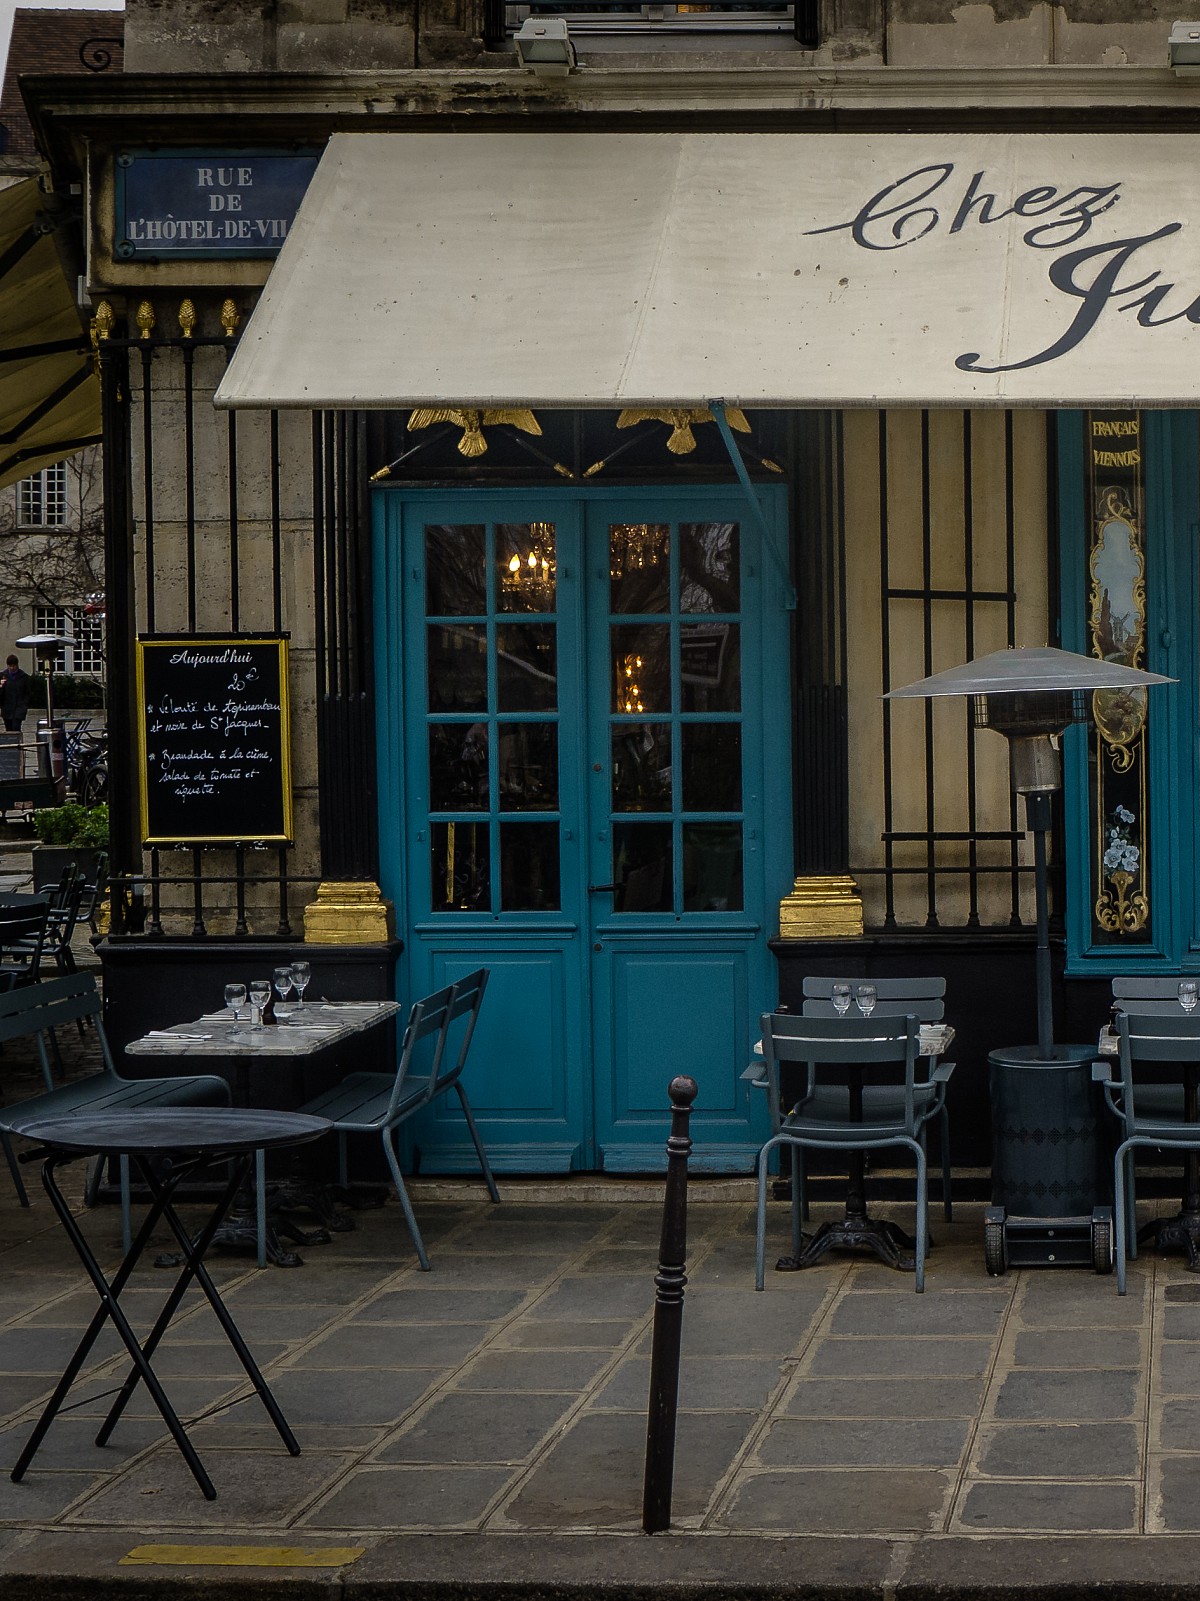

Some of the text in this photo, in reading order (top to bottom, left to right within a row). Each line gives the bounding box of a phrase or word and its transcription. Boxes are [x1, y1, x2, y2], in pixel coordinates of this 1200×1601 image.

[197, 167, 253, 187] RUE
[209, 194, 242, 212] DE
[802, 163, 1122, 250] Chez
[1092, 421, 1139, 438] FRANÇAIS
[1093, 449, 1141, 468] VIENNOIS
[169, 648, 253, 669] Aujourd'hui
[203, 701, 219, 713] de
[149, 719, 163, 733] et
[191, 719, 205, 730] de
[219, 748, 227, 759] à
[228, 746, 244, 760] la
[158, 768, 191, 783] salade
[193, 770, 206, 781] de
[244, 767, 260, 779] et
